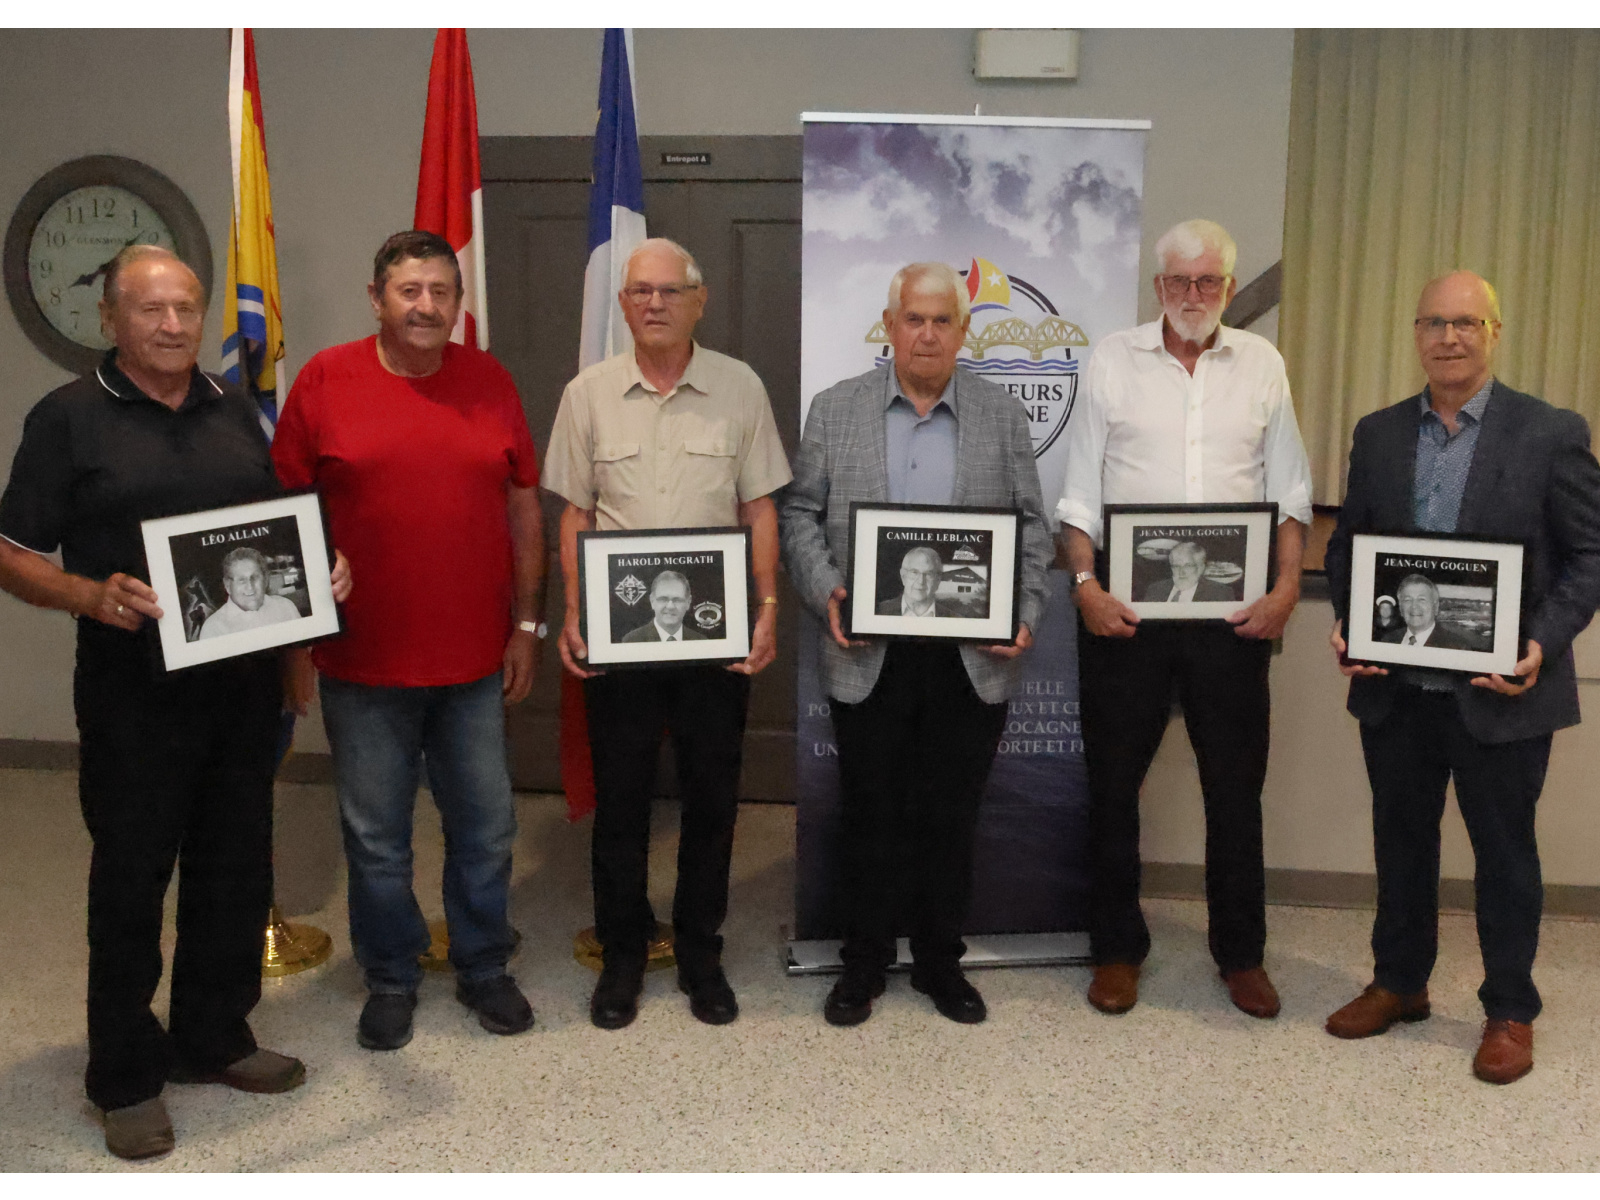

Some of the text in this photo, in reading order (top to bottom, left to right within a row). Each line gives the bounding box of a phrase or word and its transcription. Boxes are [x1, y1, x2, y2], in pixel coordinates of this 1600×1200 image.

[66, 206, 84, 224] 11
[92, 198, 116, 218] 12
[132, 209, 139, 228] 1
[45, 230, 66, 248] 10
[40, 259, 53, 279] 9
[50, 286, 61, 306] 8
[70, 311, 80, 330] 7
[1000, 383, 1063, 401] EURS
[201, 525, 269, 546] LÉO ALLAIN
[886, 531, 984, 543] CAMILLE LEBLANC
[1140, 528, 1240, 537] JEAN-PAUL GOGUEN
[618, 555, 714, 567] HAROLD McGRATH
[1384, 557, 1488, 572] JEAN-GUY GOGUEN
[1007, 701, 1034, 715] UX
[1039, 701, 1060, 715] ET
[1046, 739, 1067, 753] ET
